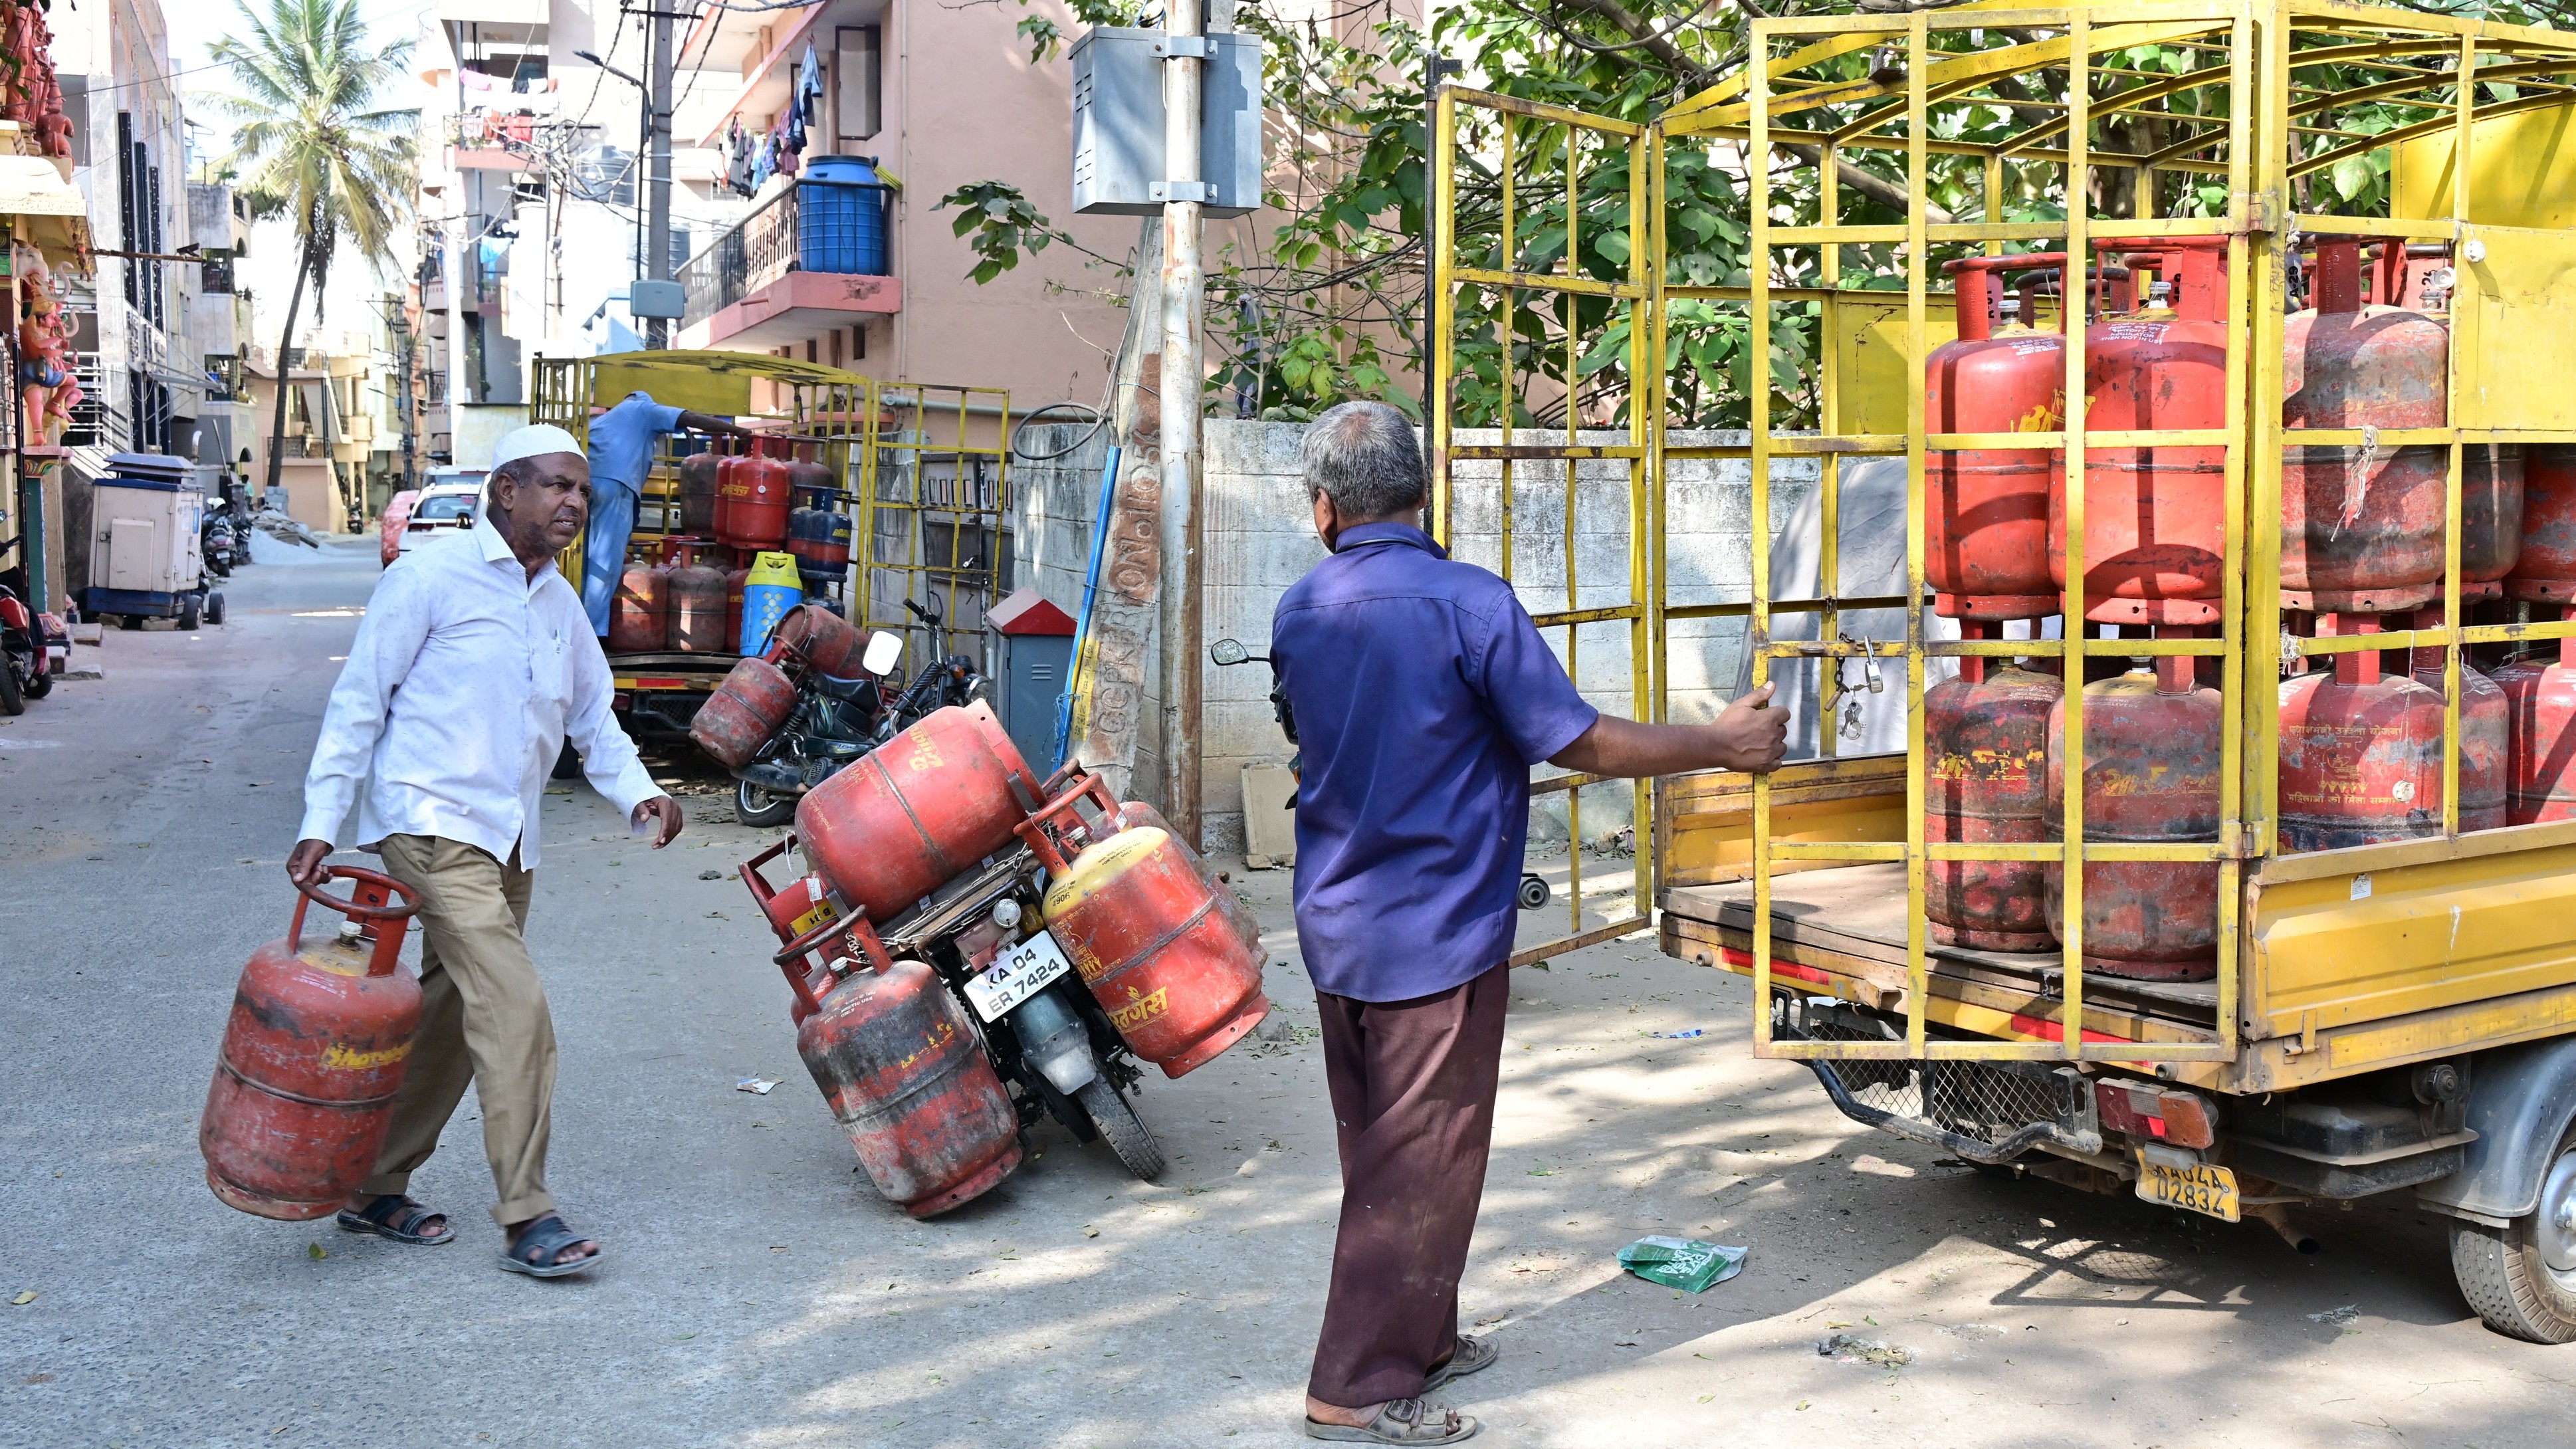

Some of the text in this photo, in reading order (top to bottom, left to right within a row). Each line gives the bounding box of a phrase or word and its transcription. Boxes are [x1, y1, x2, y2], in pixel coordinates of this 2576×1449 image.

[2288, 266, 2299, 298] A-29
[986, 948, 1037, 990] KA 04
[988, 958, 1060, 1014] ER 7424
